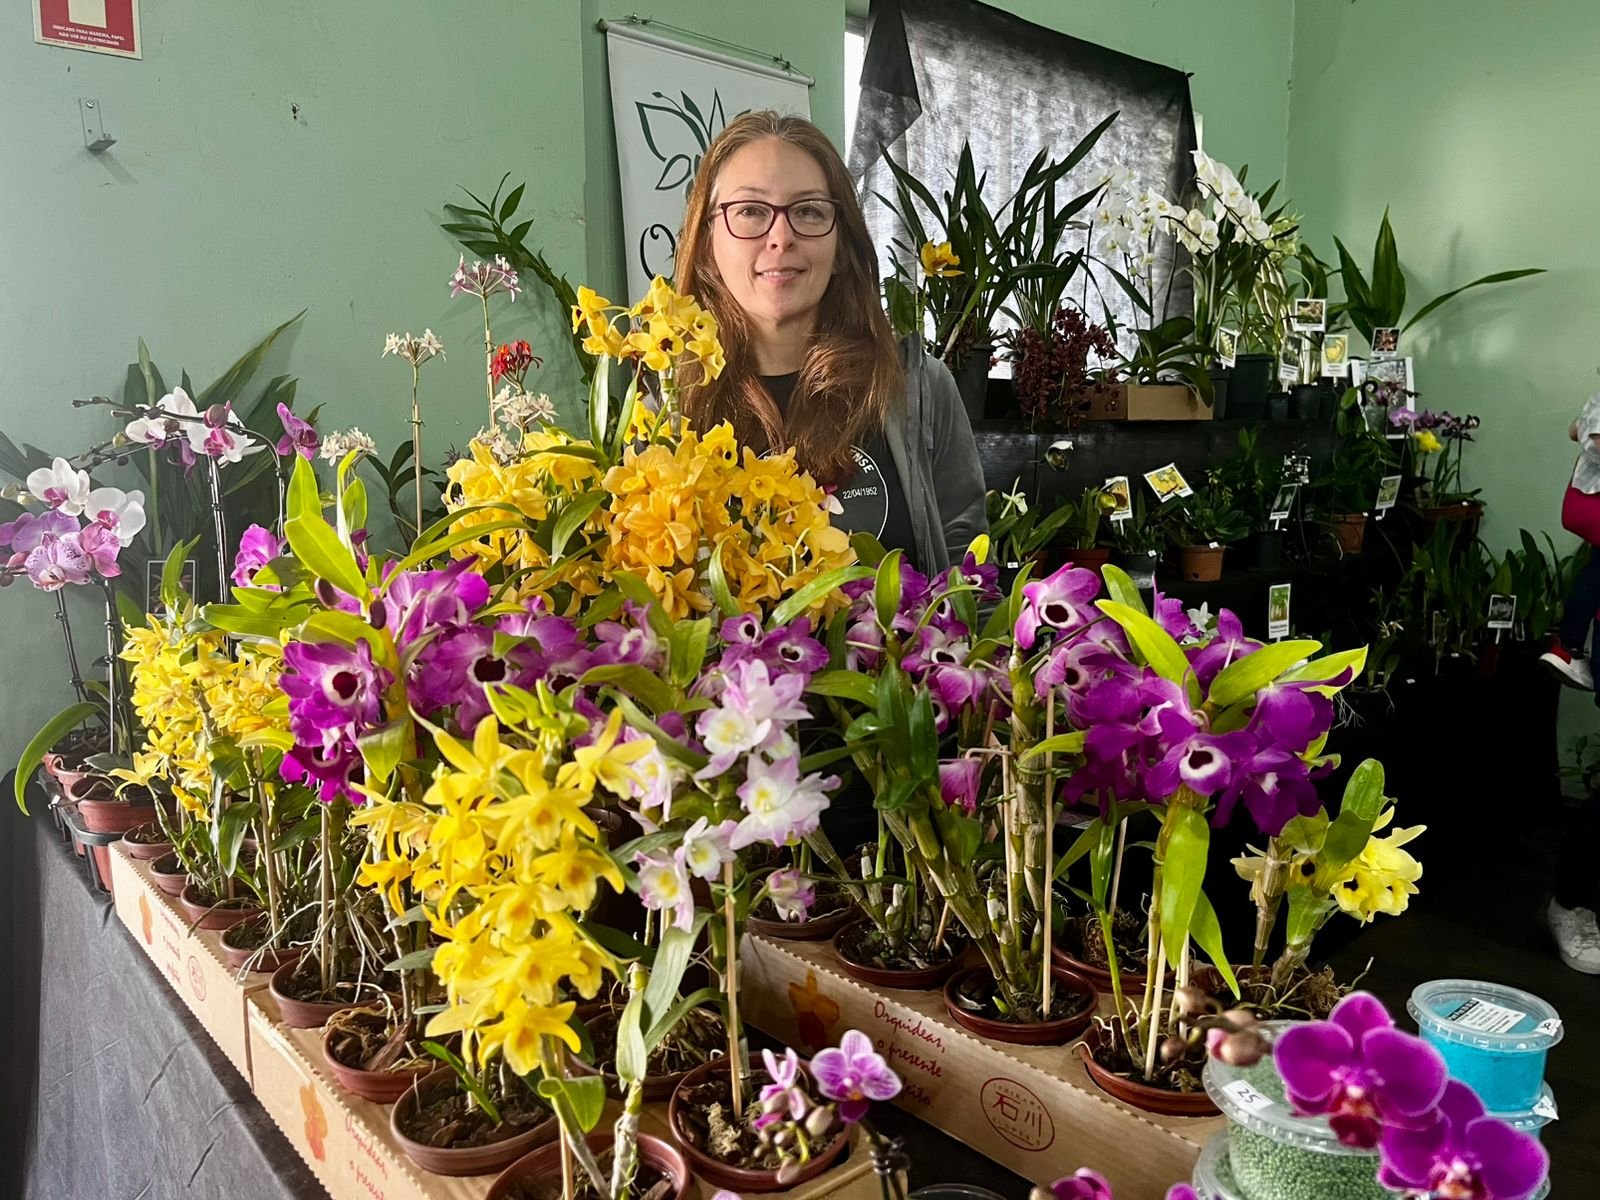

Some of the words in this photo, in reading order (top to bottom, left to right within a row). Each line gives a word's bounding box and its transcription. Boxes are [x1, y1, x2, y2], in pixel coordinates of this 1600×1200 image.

[89, 31, 111, 39] MADEIRA,
[842, 486, 878, 500] 22/04/1952
[888, 1045, 942, 1078] presente
[1237, 1088, 1262, 1104] 25
[992, 1090, 1042, 1138] 石川
